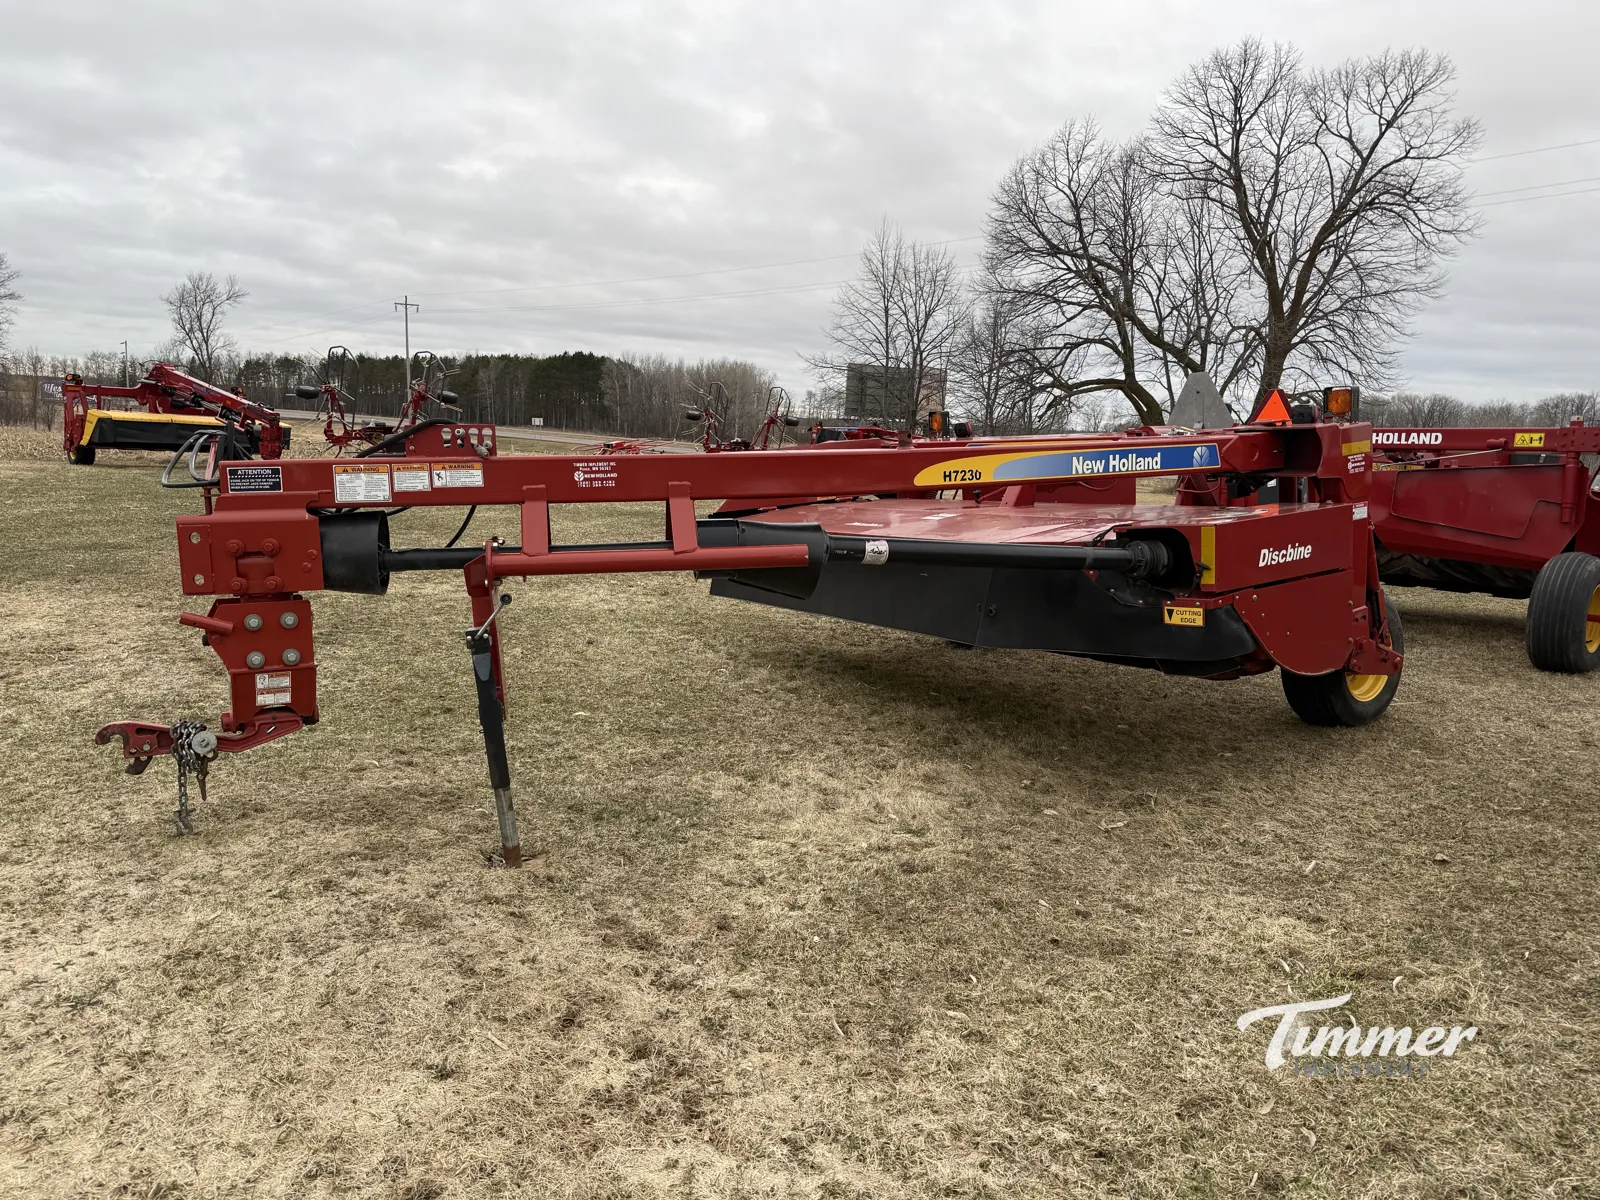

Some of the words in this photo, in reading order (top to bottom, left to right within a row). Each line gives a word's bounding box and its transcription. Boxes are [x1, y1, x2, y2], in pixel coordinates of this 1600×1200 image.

[1372, 432, 1443, 445] HOLLAND
[1072, 456, 1105, 475] New
[1109, 452, 1161, 472] Holland
[943, 469, 982, 482] H7230
[1258, 542, 1312, 567] Discbine
